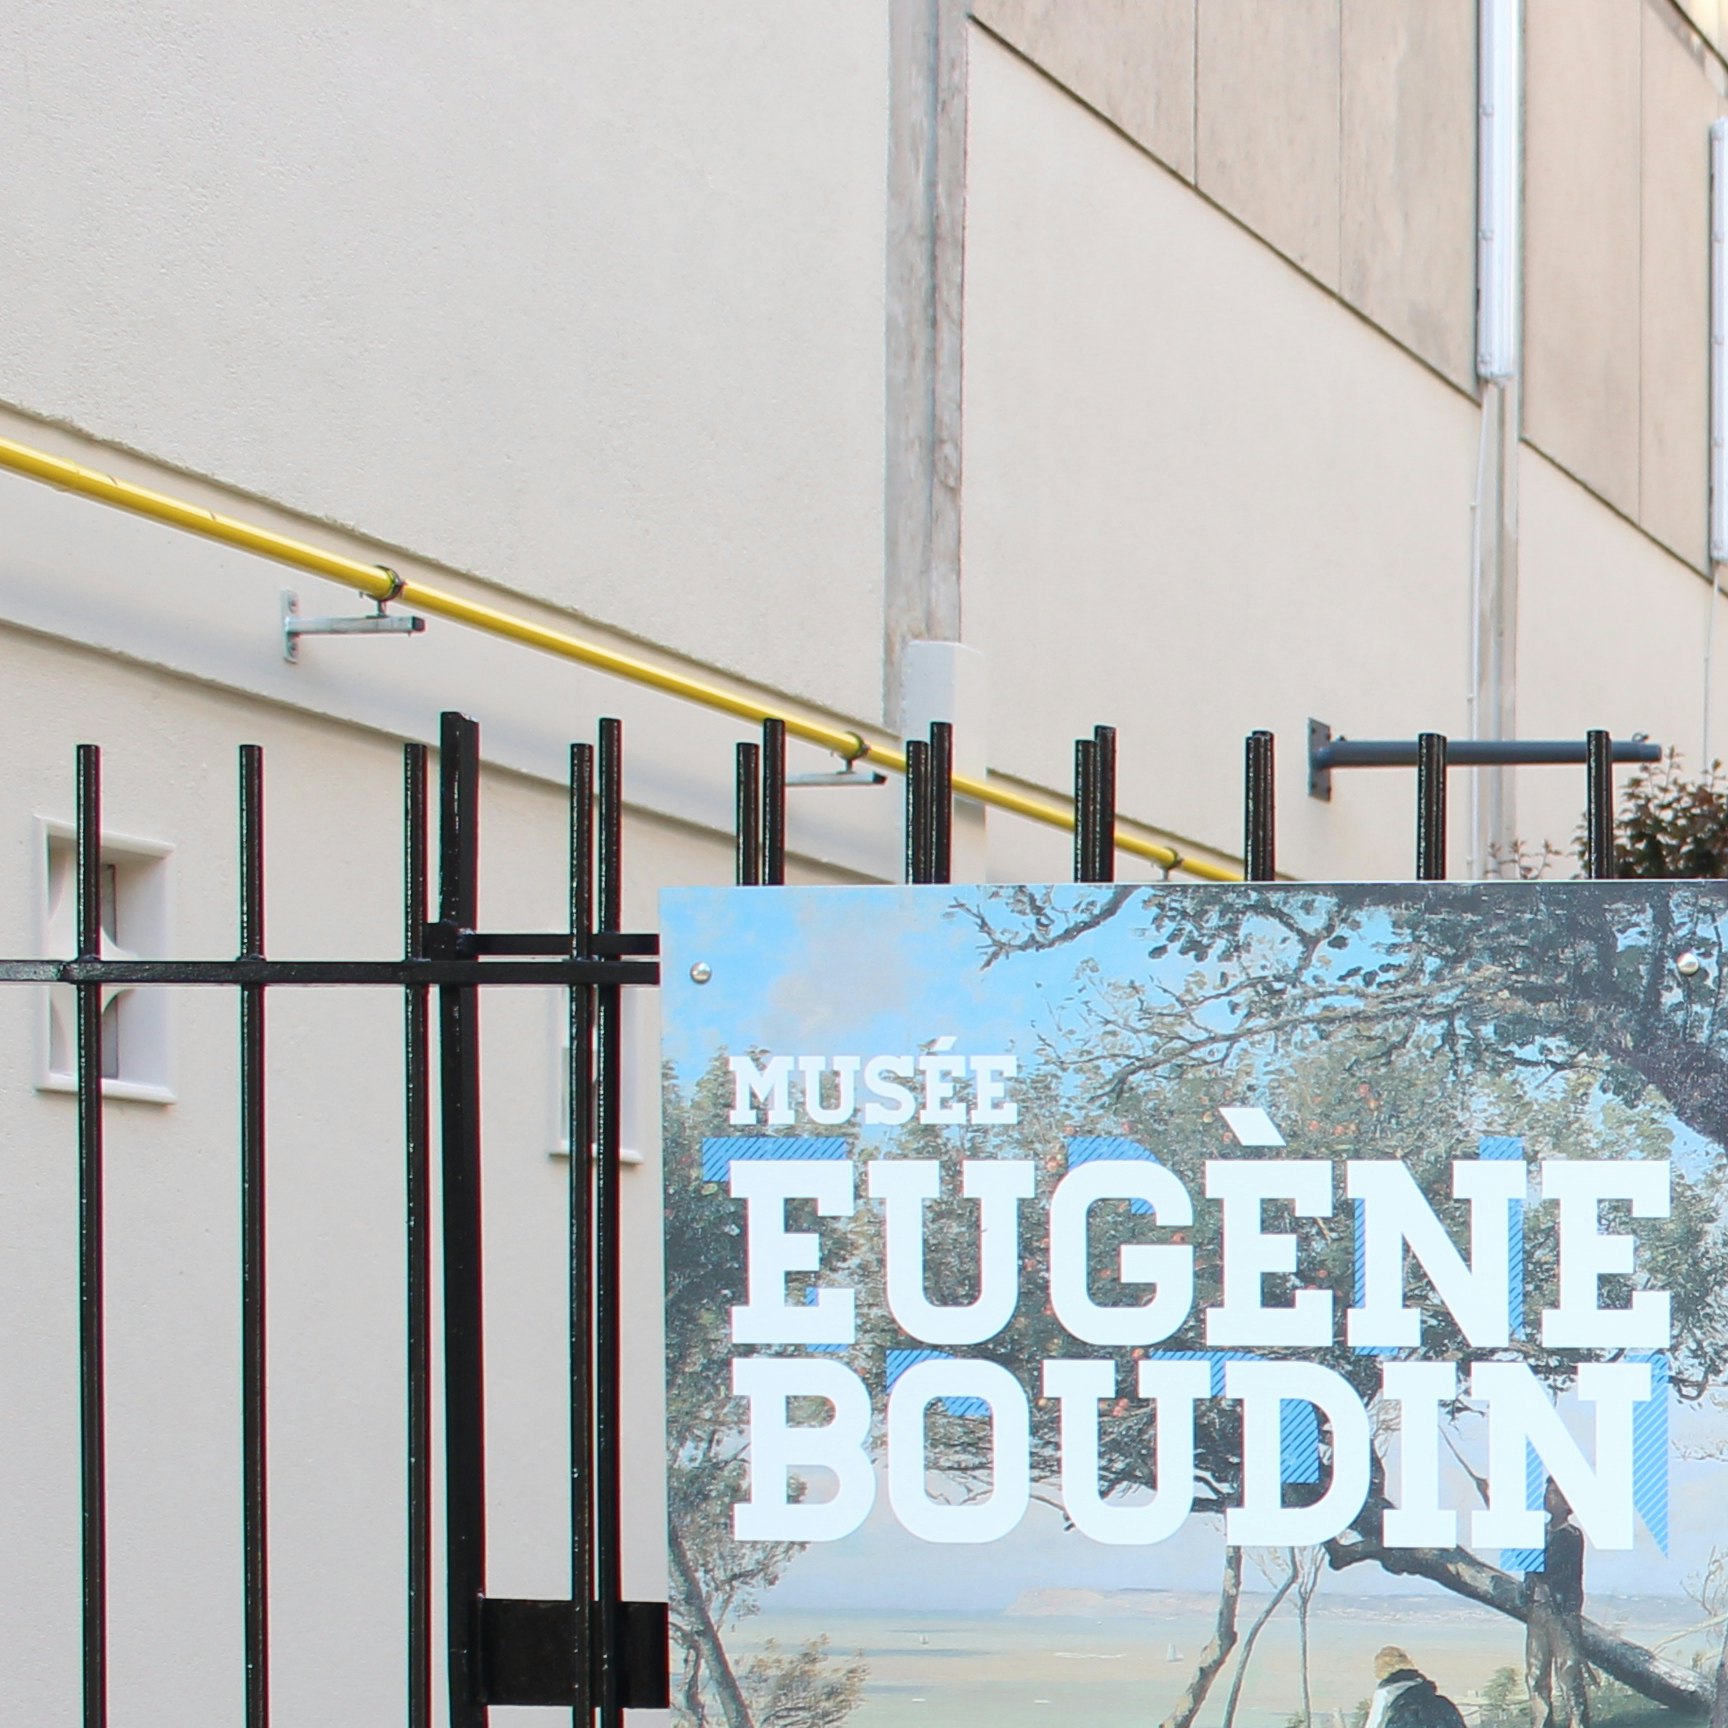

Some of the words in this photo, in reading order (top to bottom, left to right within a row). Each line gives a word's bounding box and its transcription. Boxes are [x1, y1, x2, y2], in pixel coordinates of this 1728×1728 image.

[728, 1037, 1018, 1126] MUSÉE
[729, 1107, 1672, 1349] EUGÈNE
[731, 1357, 1652, 1551] BOUDIN
